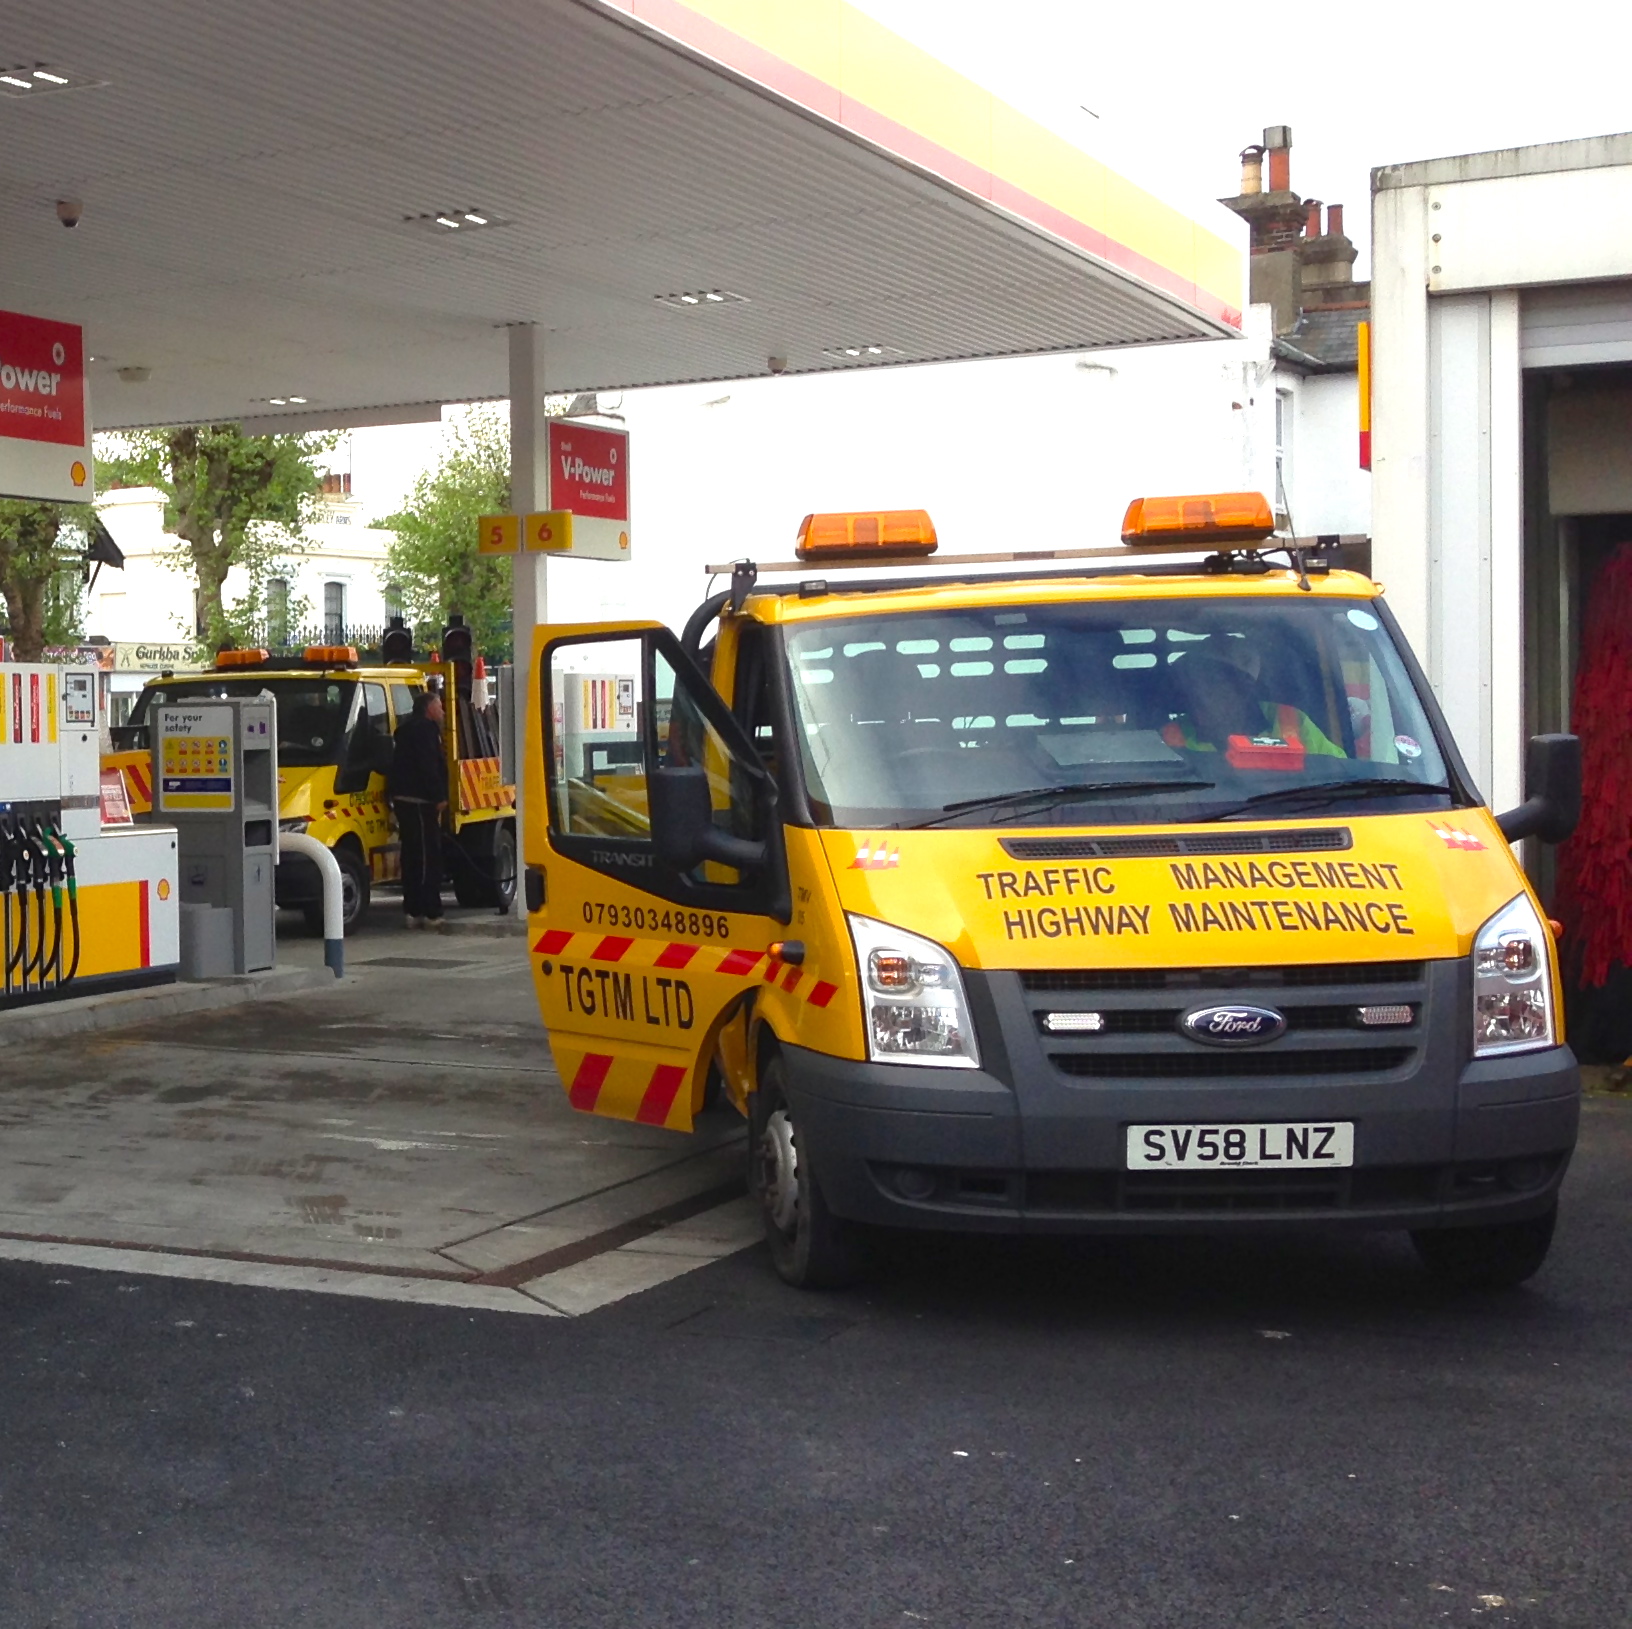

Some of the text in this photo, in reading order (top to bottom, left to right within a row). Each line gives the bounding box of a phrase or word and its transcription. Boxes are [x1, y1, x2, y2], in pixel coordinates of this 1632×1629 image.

[43, 405, 62, 421] Fuels
[561, 455, 615, 486] V-Power
[490, 523, 552, 545] 5 6
[164, 714, 202, 723] For your
[165, 724, 192, 733] safety
[592, 851, 656, 867] TRANSIT
[977, 862, 1404, 900] TRAFFIC MANAGEMENT
[582, 901, 729, 938] 07930348896
[1003, 903, 1415, 940] HIGHWAY MAINTENANCE
[560, 965, 694, 1029] TGTM LTD
[1209, 1011, 1261, 1035] Ford
[1143, 1127, 1336, 1161] SV58 LNZ
